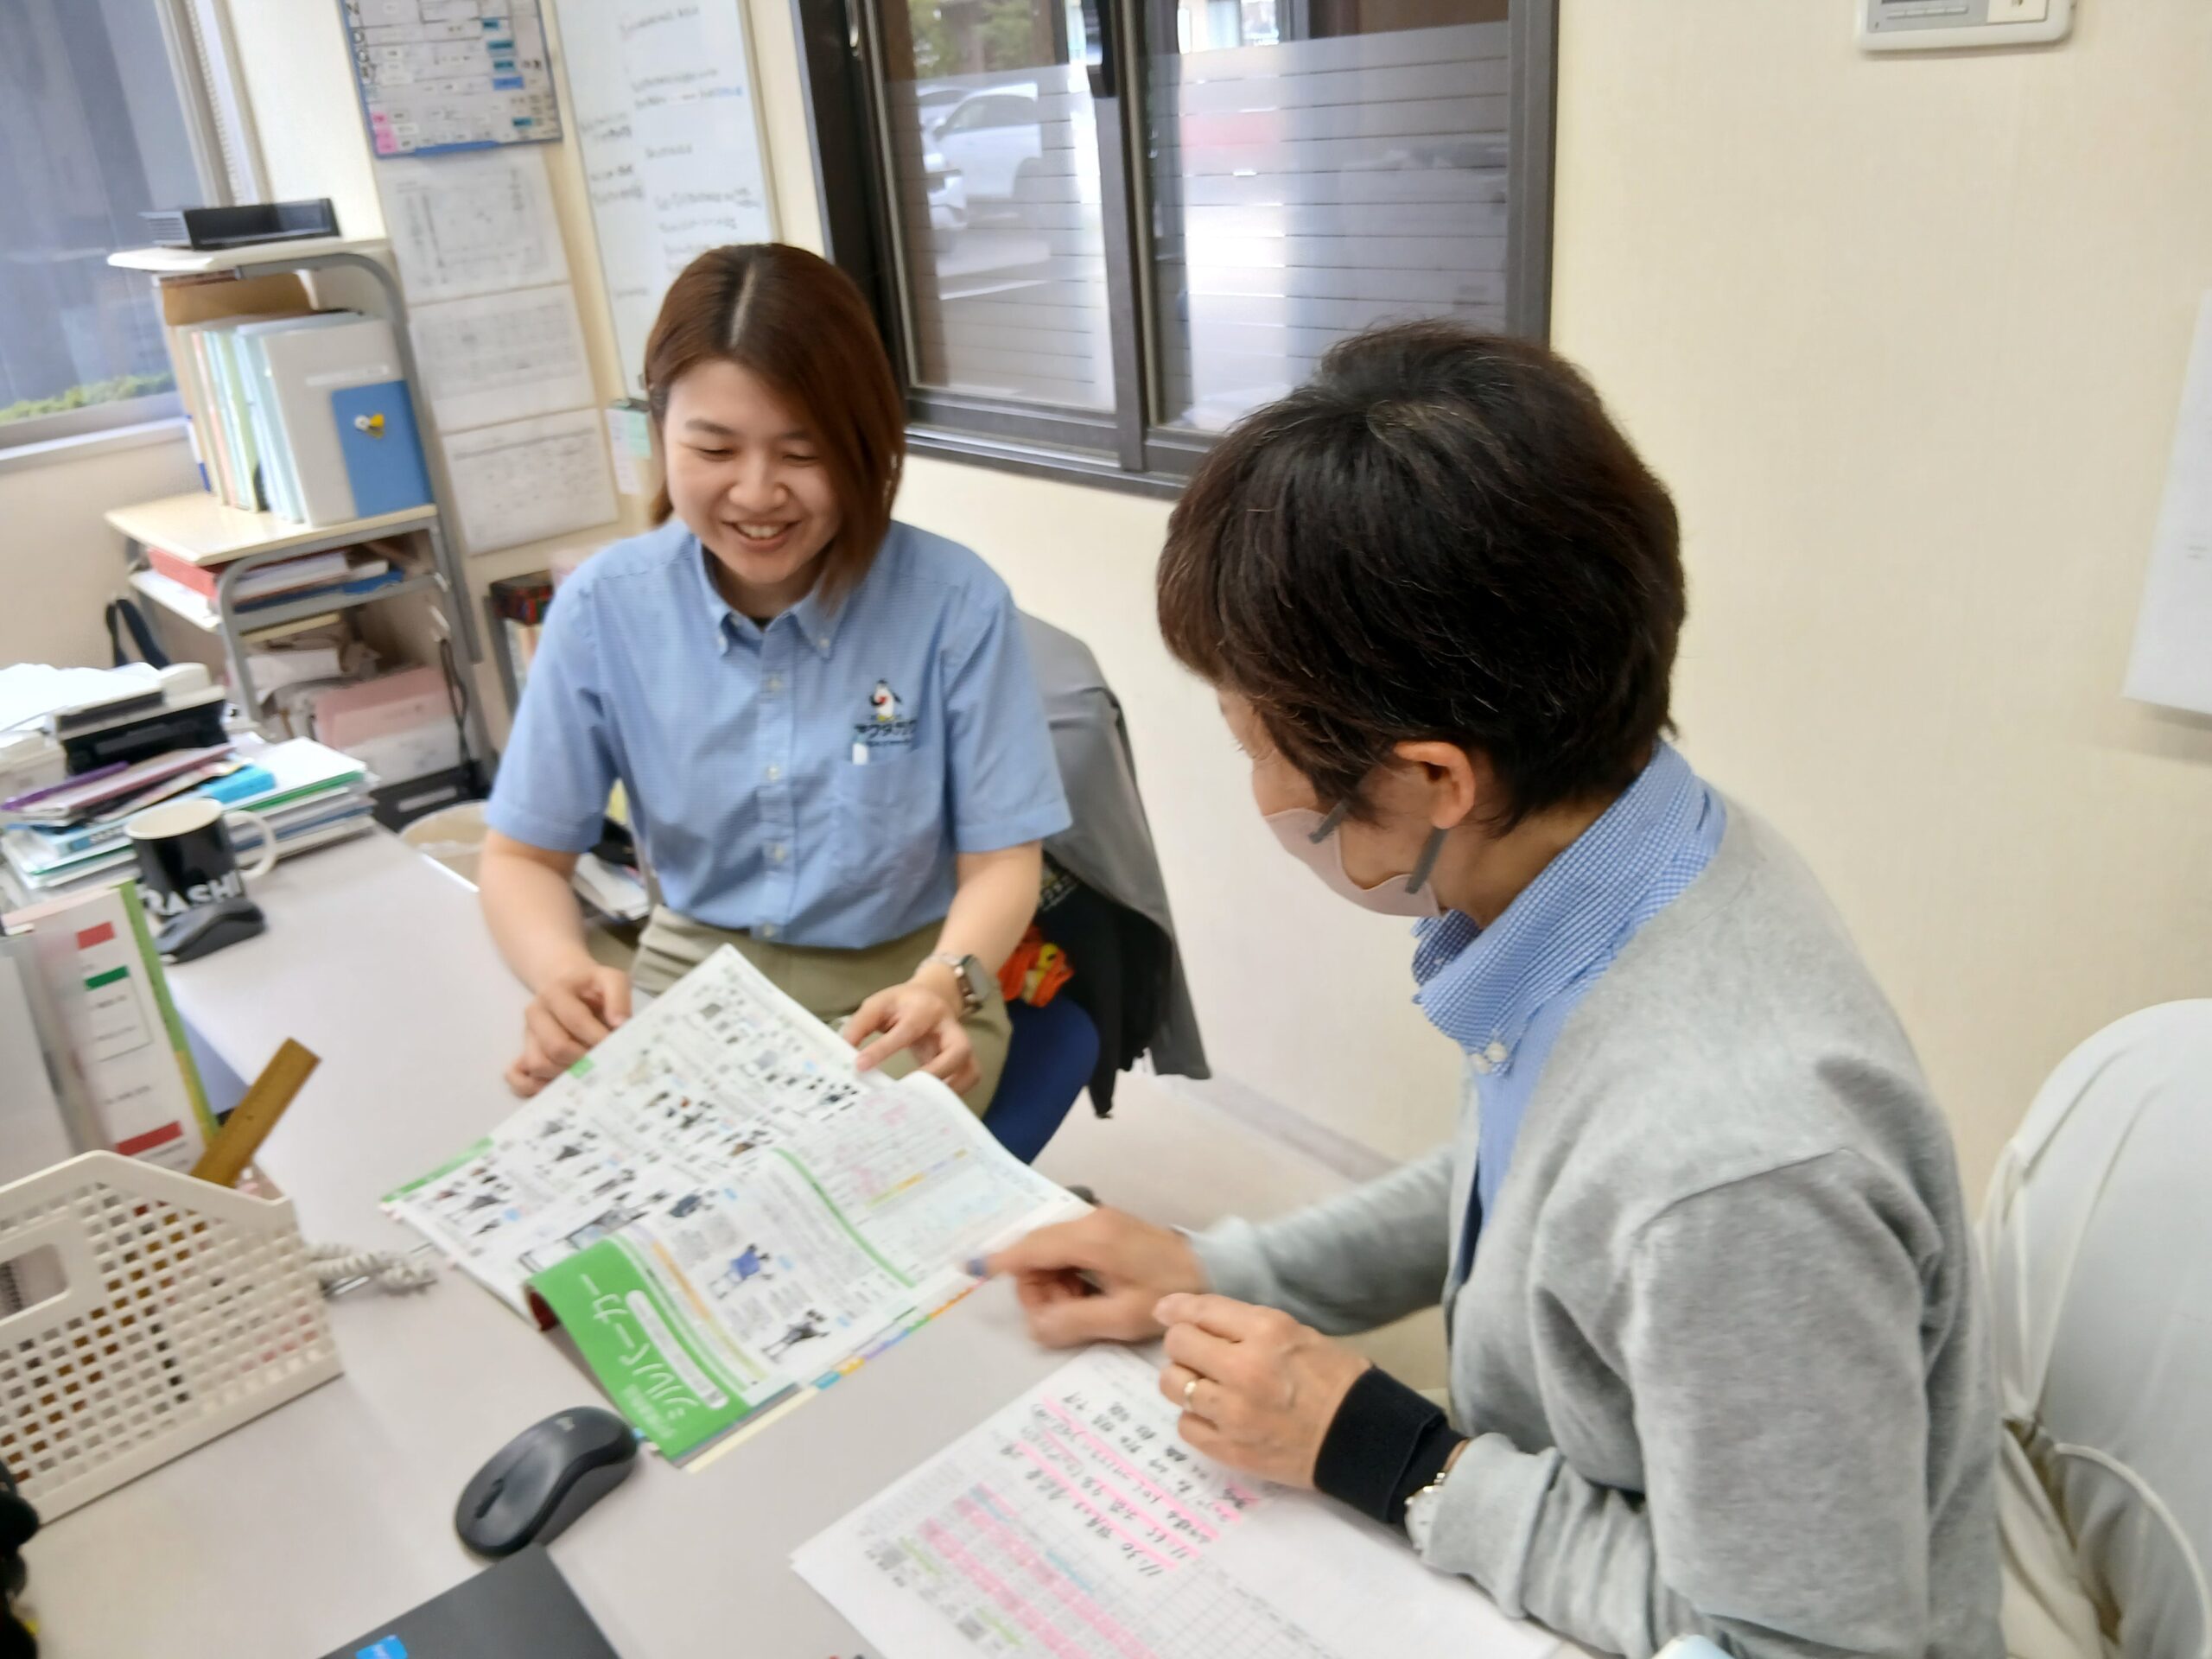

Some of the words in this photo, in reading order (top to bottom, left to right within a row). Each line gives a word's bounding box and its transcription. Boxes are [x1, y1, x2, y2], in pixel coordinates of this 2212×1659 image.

[580, 1273, 699, 1420] シルバーカー
